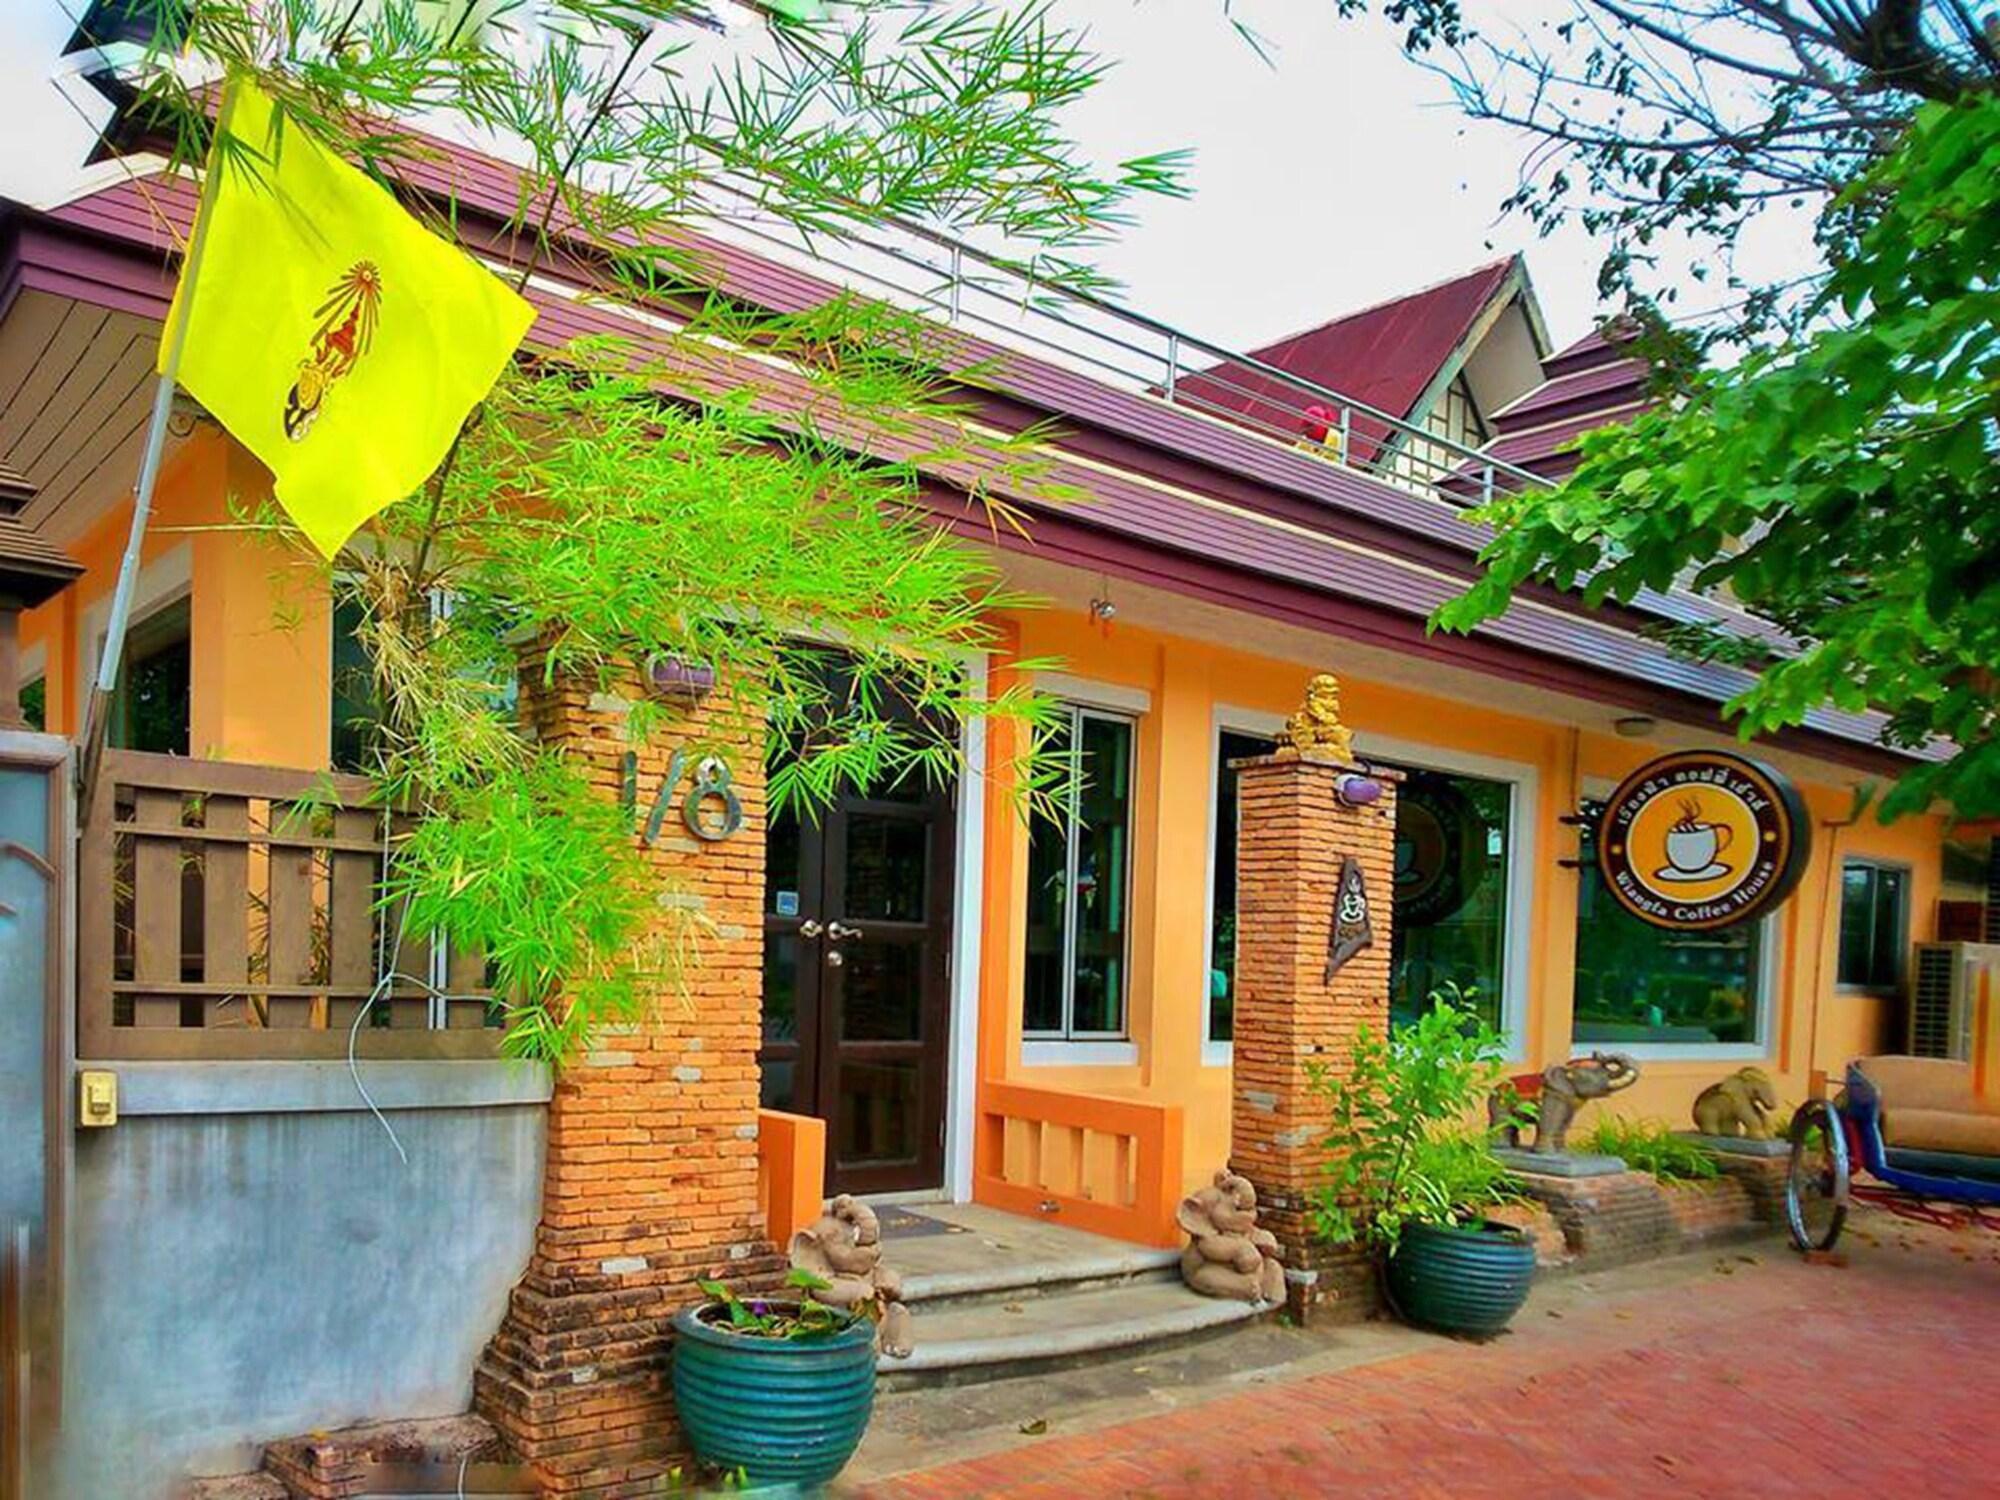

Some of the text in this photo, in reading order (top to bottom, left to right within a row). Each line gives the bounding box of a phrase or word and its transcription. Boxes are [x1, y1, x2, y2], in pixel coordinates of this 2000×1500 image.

[624, 747, 742, 843] 1/8
[1615, 861, 1774, 921] Wiangfa Coffee House
